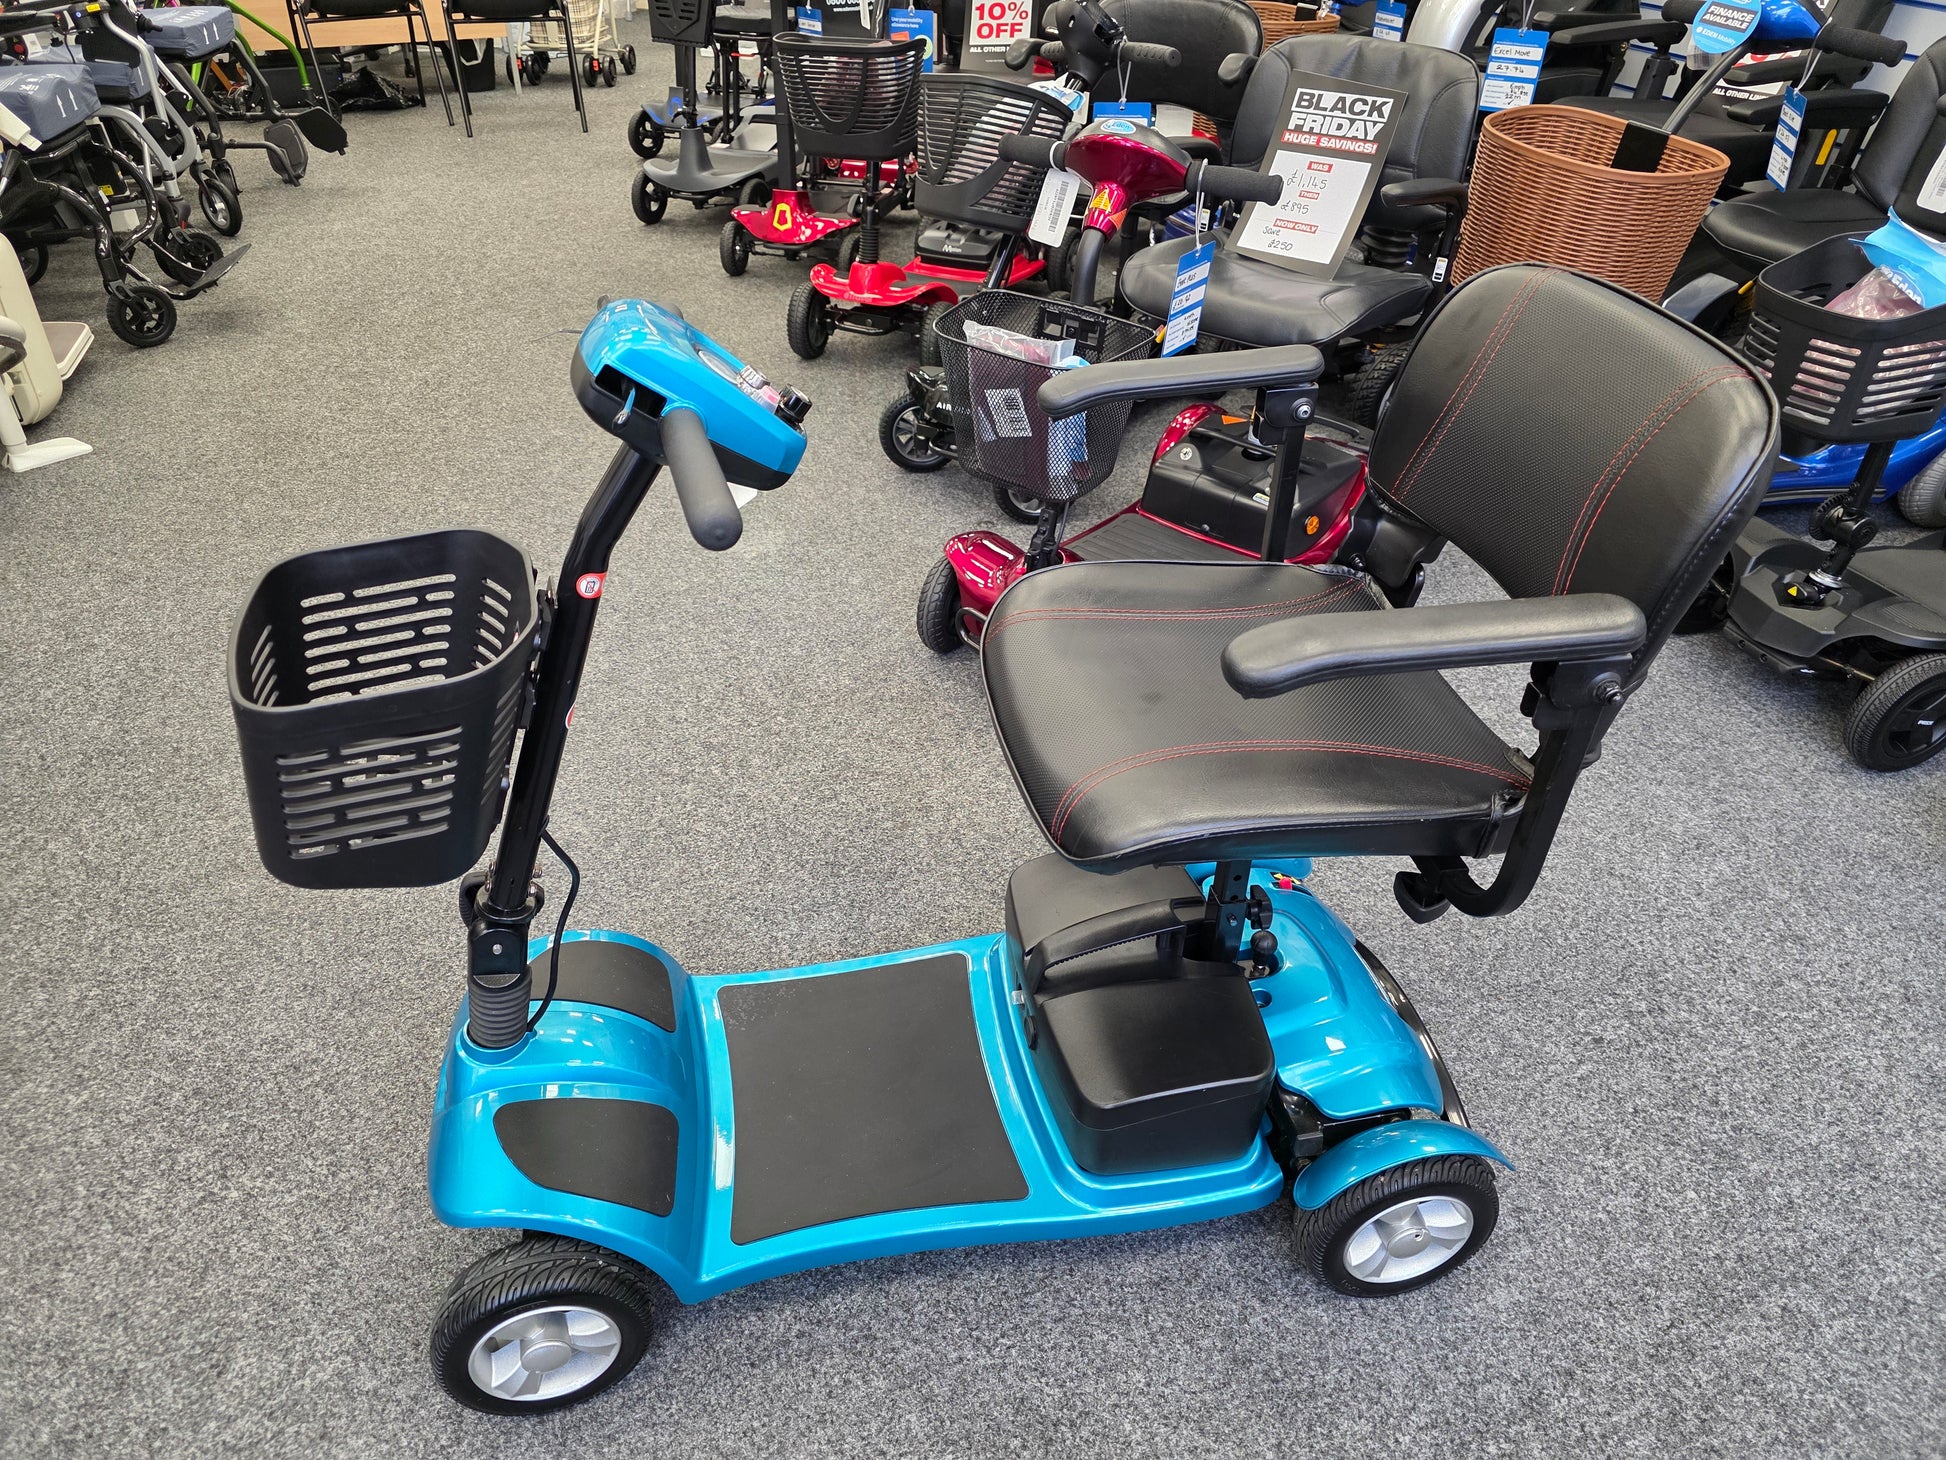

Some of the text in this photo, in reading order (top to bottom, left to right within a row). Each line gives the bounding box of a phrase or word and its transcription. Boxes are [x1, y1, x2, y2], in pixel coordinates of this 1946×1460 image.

[975, 1, 1029, 20] 10%
[1708, 5, 1755, 22] FINANCE
[1702, 13, 1750, 30] AVAILABLE
[976, 22, 1024, 39] OFF
[1702, 28, 1736, 46] EDEN Mobility
[1712, 87, 1725, 95] ALL
[1726, 90, 1749, 100] OTHER
[1295, 91, 1391, 119] BLACK
[1287, 112, 1385, 141] FRIDAY
[1284, 132, 1378, 154] HUGE SAVINGS!
[1310, 162, 1329, 171] WAS
[1300, 191, 1319, 199] THEN
[1280, 200, 1309, 215] £895
[1275, 219, 1317, 233] NOW ONLY
[1267, 239, 1294, 251] £250
[936, 401, 952, 411] AIR
